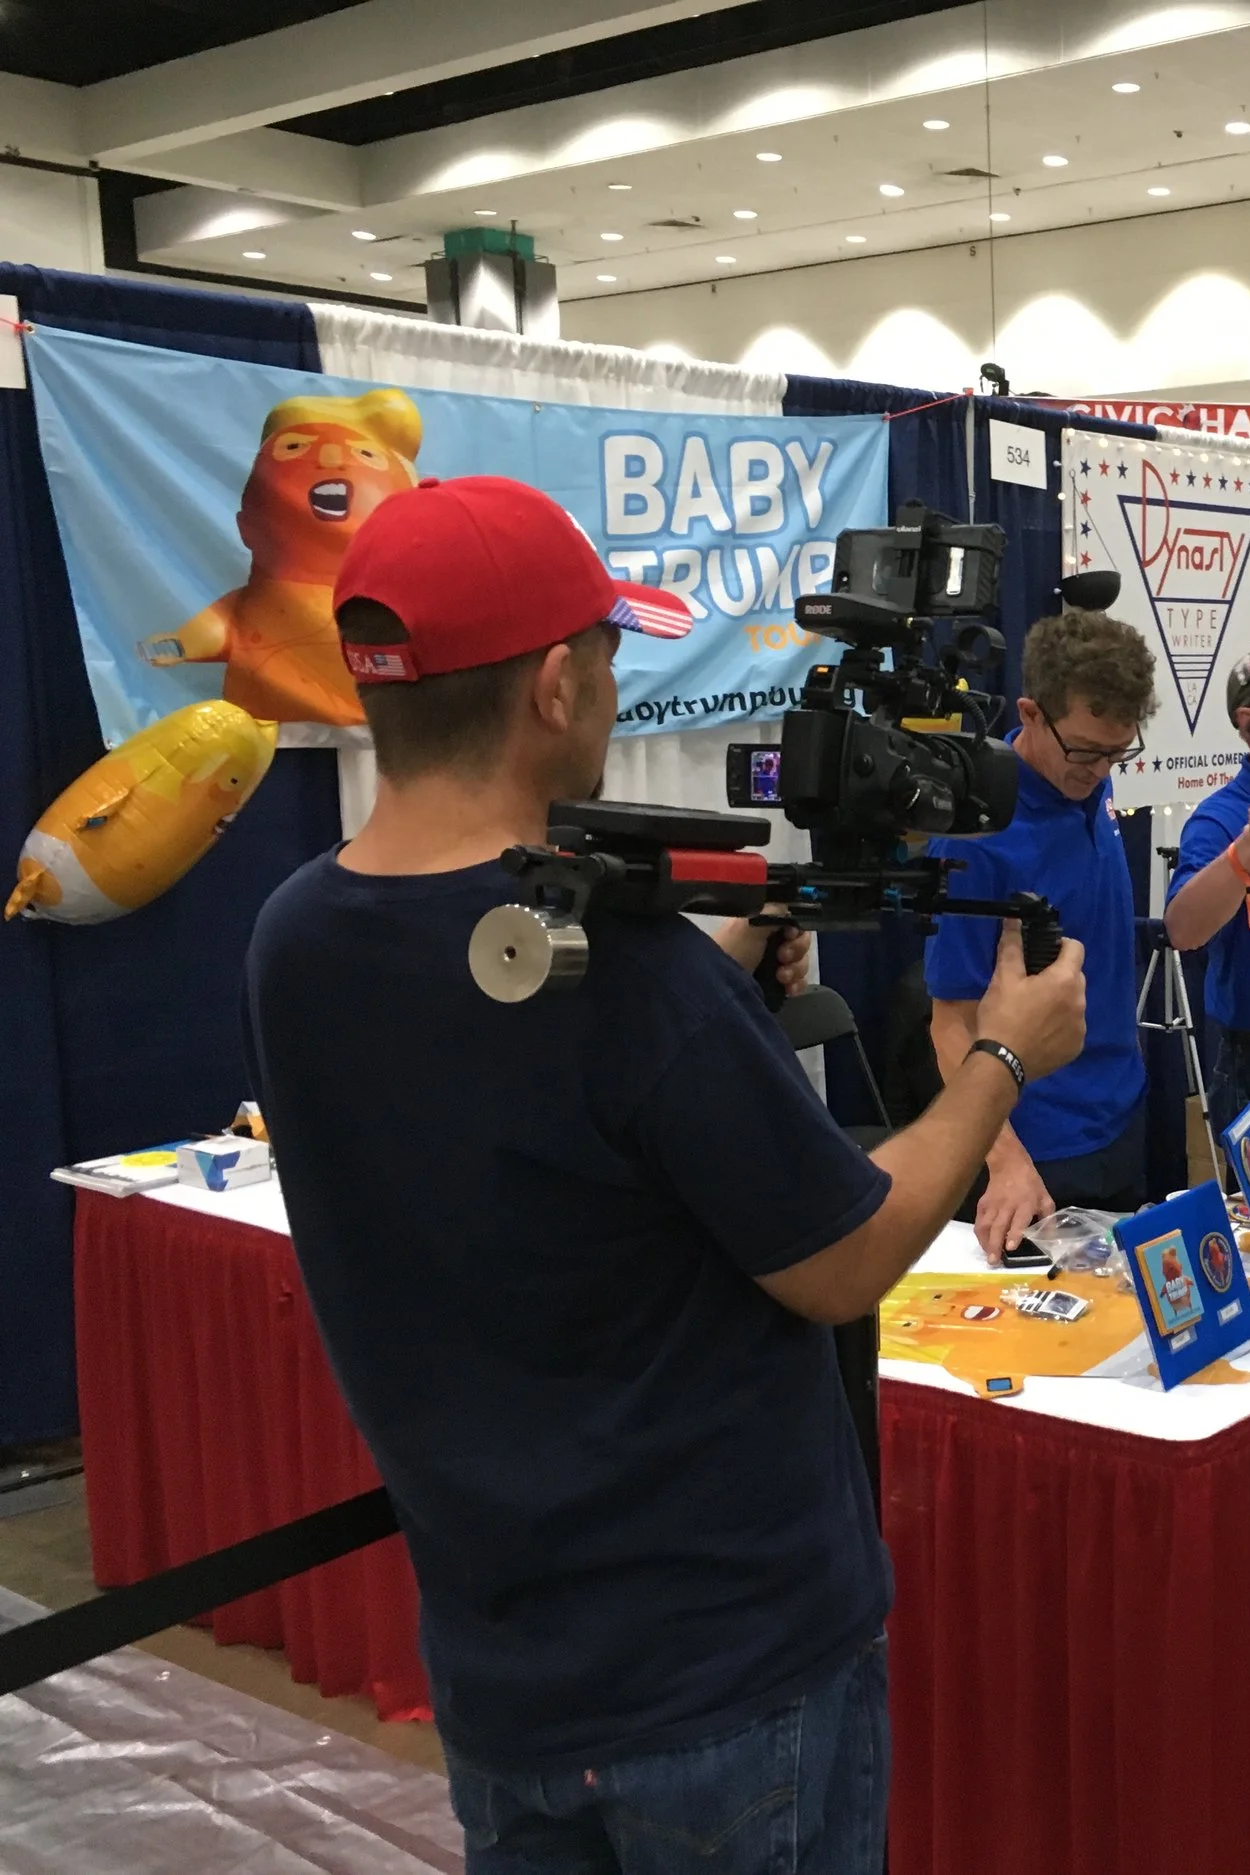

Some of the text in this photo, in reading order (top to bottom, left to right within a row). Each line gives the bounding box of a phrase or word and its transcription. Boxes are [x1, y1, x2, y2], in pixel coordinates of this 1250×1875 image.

[1007, 445, 1031, 468] 534
[603, 433, 835, 536] BABY
[1167, 608, 1217, 629] TYPE
[1172, 634, 1212, 648] WRITER
[1166, 751, 1250, 770] OFFICIAL COMED
[1178, 776, 1203, 790] Home
[1207, 773, 1218, 787] Of
